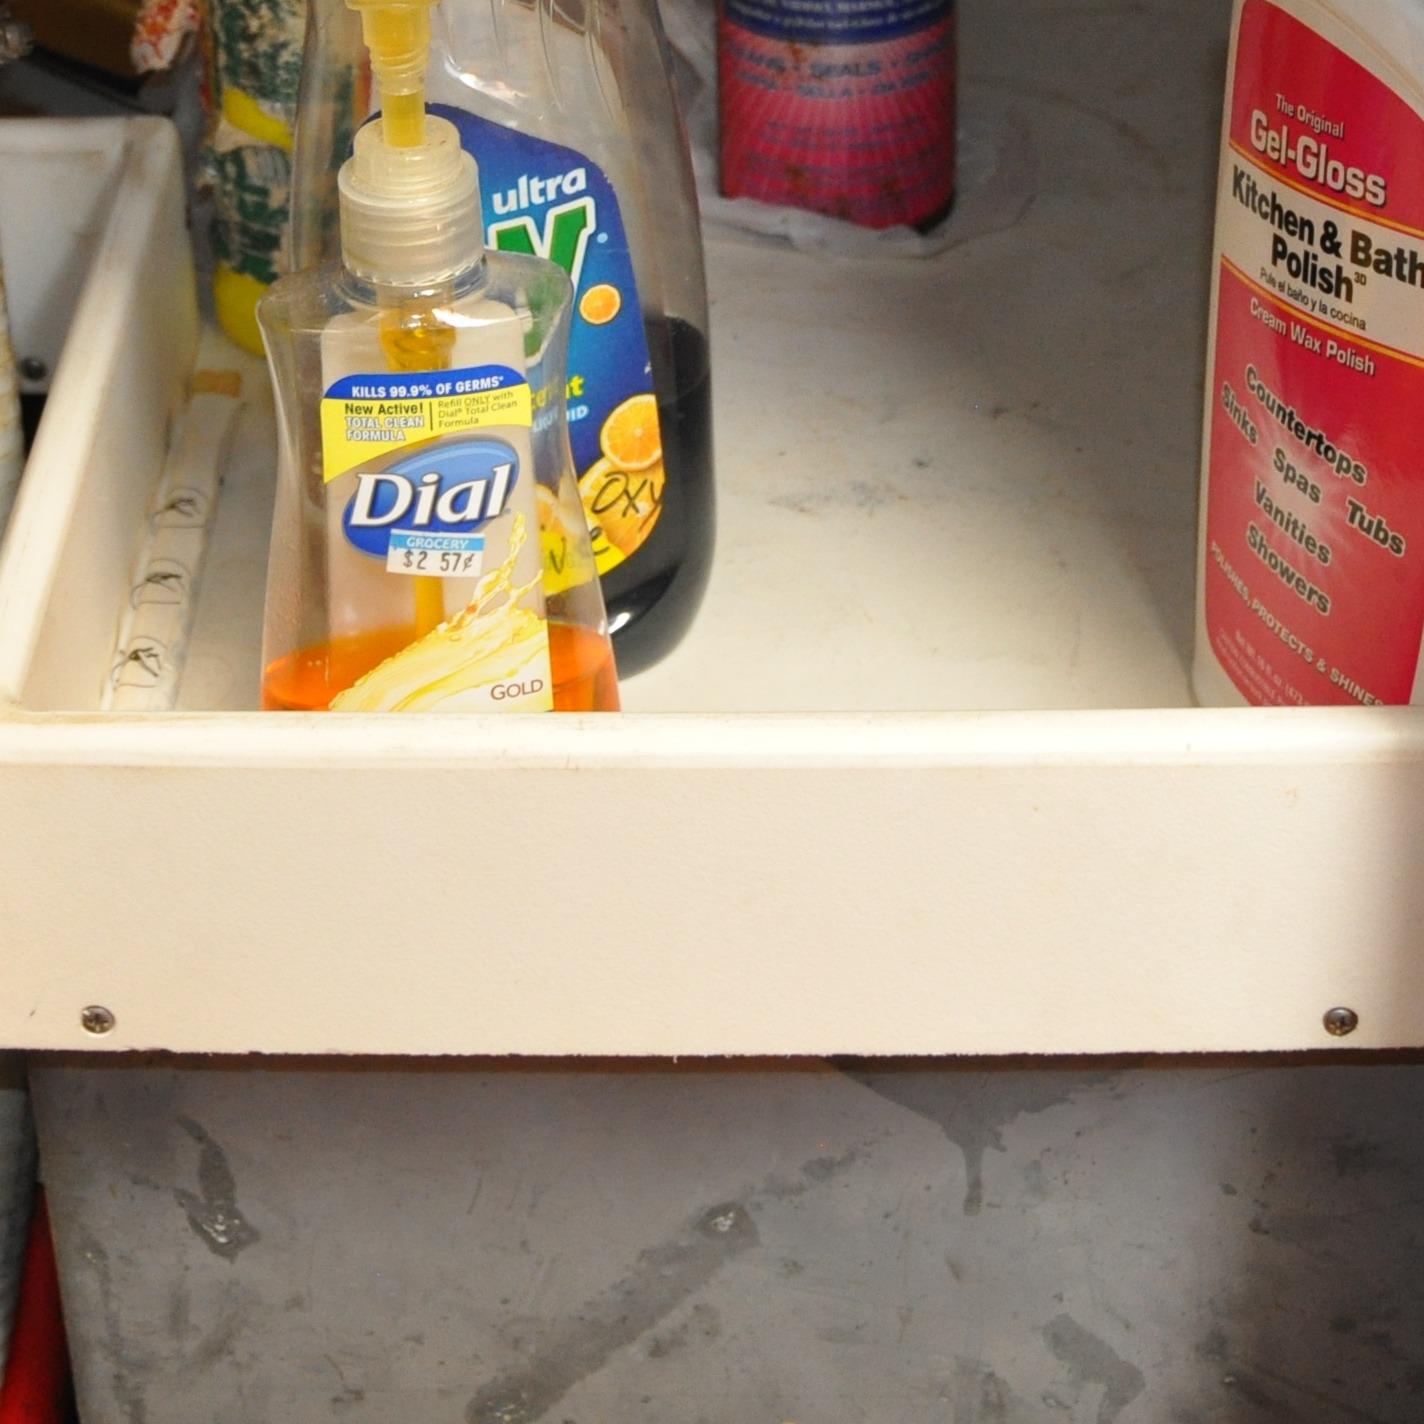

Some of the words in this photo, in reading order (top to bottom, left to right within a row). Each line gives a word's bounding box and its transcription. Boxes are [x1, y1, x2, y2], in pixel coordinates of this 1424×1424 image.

[1276, 93, 1293, 117] The
[1297, 105, 1344, 138] Original
[1250, 109, 1387, 207] Gel-Gloss
[492, 167, 586, 214] ultra
[1232, 164, 1315, 246] Kitchen
[1320, 221, 1342, 259] &
[1271, 232, 1353, 304] Polish
[1250, 296, 1287, 337] Cream
[1291, 321, 1321, 353] Wax
[1326, 339, 1375, 375] Polish
[1330, 307, 1367, 331] cocina
[345, 403, 373, 415] New
[377, 403, 424, 415] Active!
[351, 386, 386, 398] KILLS
[389, 385, 432, 397] 99.9%
[436, 383, 450, 395] OF
[438, 397, 463, 409] Refill
[464, 396, 490, 407] ONLY
[492, 391, 514, 402] with
[466, 403, 490, 416] Total
[491, 400, 518, 413] Clean
[1221, 382, 1257, 445] Sinks
[345, 416, 380, 428] TOTAL
[384, 416, 424, 428] CLEAN
[346, 430, 406, 441] FORMULA
[438, 417, 479, 428] Formula
[1245, 363, 1367, 485] Countertops
[350, 463, 512, 526] Dial
[1273, 447, 1321, 504] Spas
[406, 537, 469, 550] GROCERY
[1255, 477, 1331, 565] Vanities
[1347, 496, 1405, 556] Tubs
[1247, 520, 1330, 614] Showers
[1252, 597, 1314, 664] PROTECTS
[1316, 658, 1326, 673] &
[490, 679, 544, 700] GOLD
